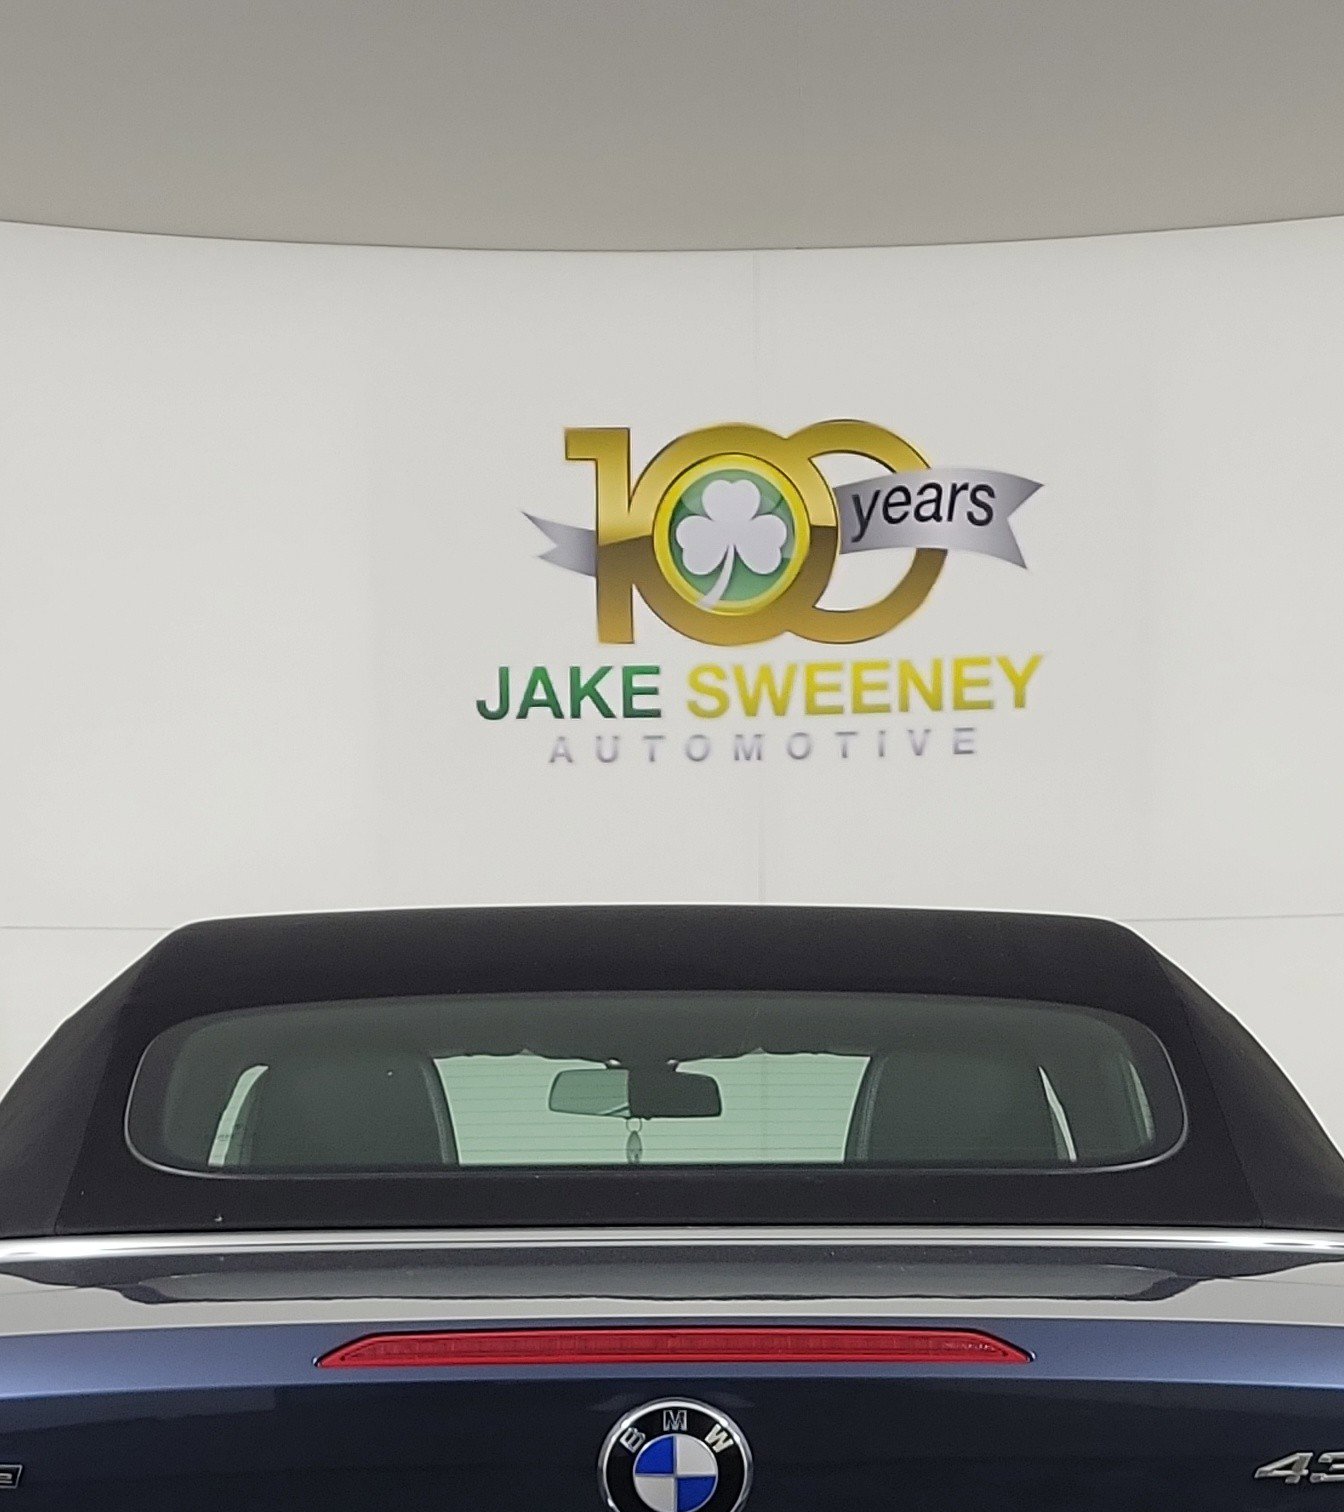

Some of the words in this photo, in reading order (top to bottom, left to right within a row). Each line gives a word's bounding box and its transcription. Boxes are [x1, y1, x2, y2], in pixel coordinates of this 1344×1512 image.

[851, 479, 997, 542] years
[475, 665, 663, 720] JAKE
[685, 654, 1045, 719] SWEENEY
[549, 727, 978, 764] AUTOMOTIVE
[618, 1409, 733, 1455] BMW
